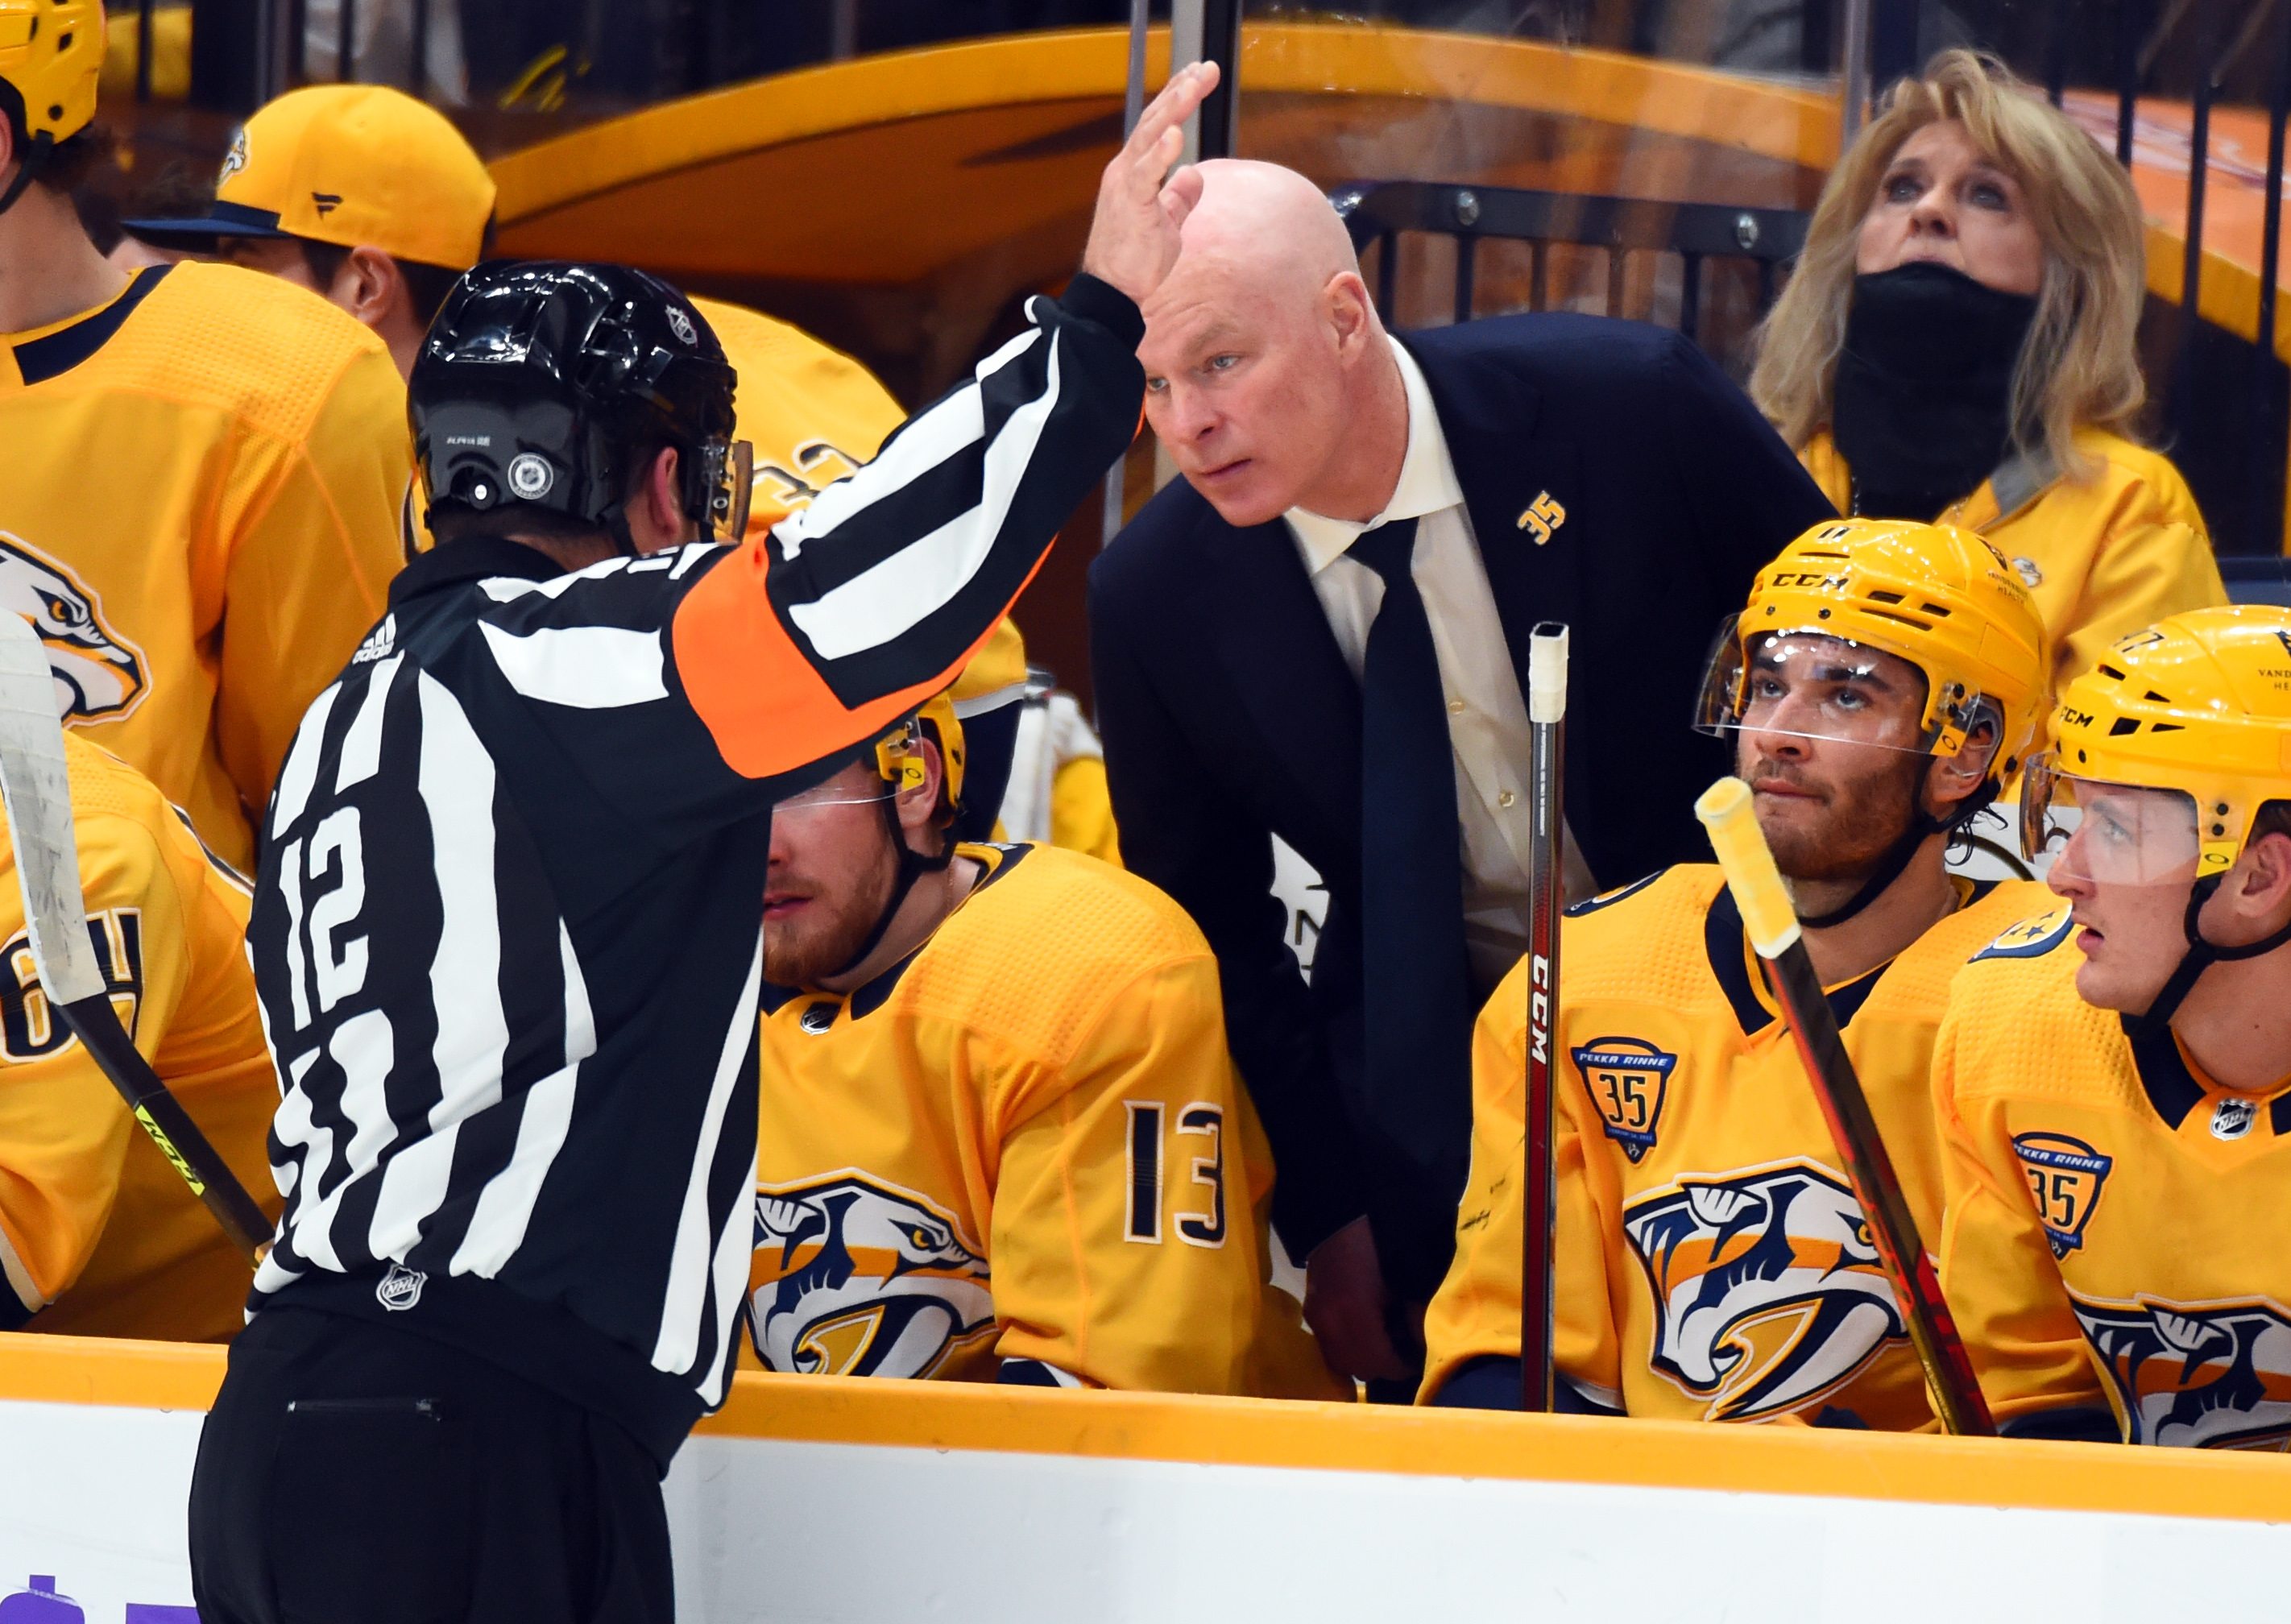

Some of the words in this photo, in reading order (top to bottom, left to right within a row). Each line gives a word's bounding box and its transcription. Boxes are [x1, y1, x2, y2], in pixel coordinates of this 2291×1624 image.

[1516, 490, 1566, 545] 35
[1772, 573, 1850, 590] CCM
[279, 806, 370, 1032] 12
[1531, 954, 1549, 1065] CCM
[1579, 1053, 1619, 1064] PEKKA
[1623, 1056, 1668, 1067] RINNE
[1598, 1072, 1647, 1128] 35
[1122, 1100, 1227, 1249] 13
[2054, 1154, 2105, 1170] RINNE
[2027, 1167, 2079, 1227] 35
